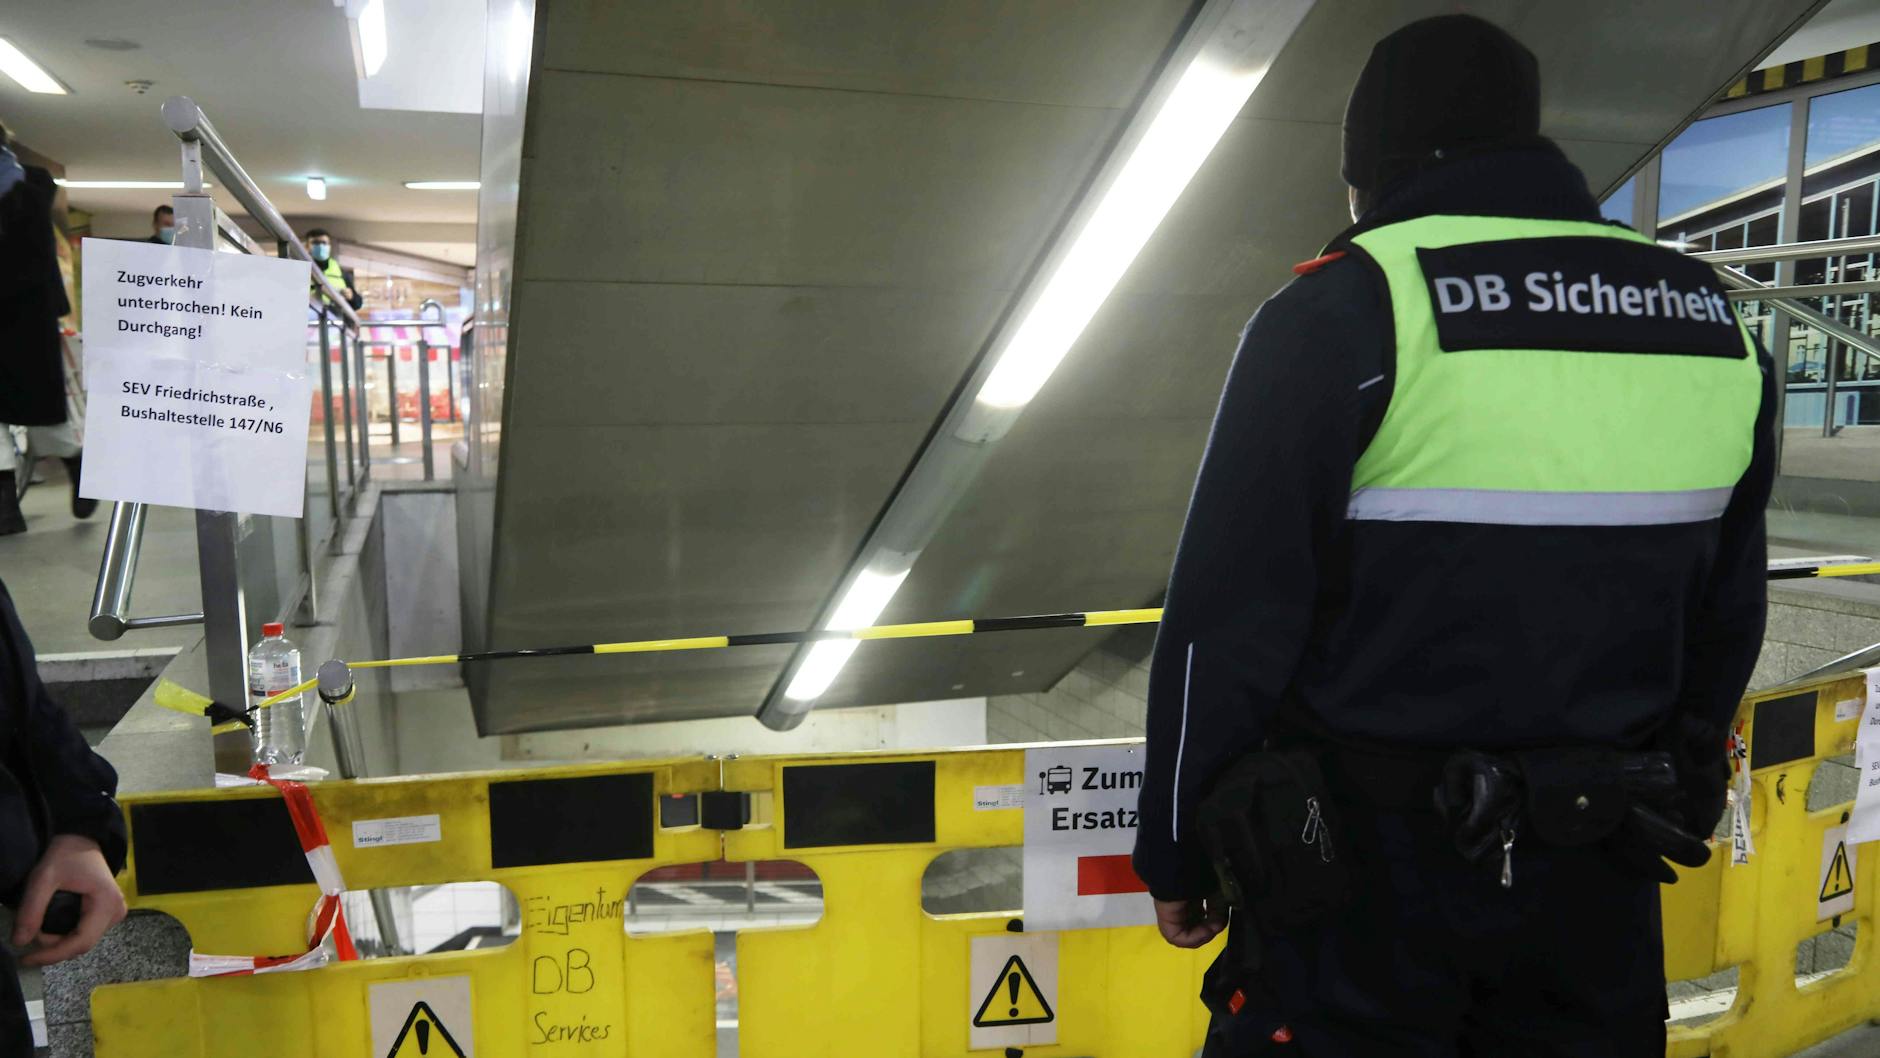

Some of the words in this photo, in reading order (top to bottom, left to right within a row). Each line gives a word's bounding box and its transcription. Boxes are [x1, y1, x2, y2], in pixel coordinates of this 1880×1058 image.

[117, 270, 203, 289] Zugverkehr
[118, 296, 225, 316] unterbrochen!
[230, 305, 263, 320] Kein
[1434, 274, 1511, 313] DB
[1524, 271, 1733, 325] Sicherheit
[118, 319, 202, 339] Durchgang!
[122, 381, 151, 396] SEV
[155, 384, 266, 409] Friedrichstraße
[121, 405, 225, 428] Bushaltestelle
[229, 416, 283, 435] 147/N6
[1082, 767, 1144, 790] Zum
[1052, 808, 1138, 831] Ersatz
[524, 886, 623, 935] Eigentum
[533, 948, 595, 994] DB
[531, 1011, 611, 1045] Services
